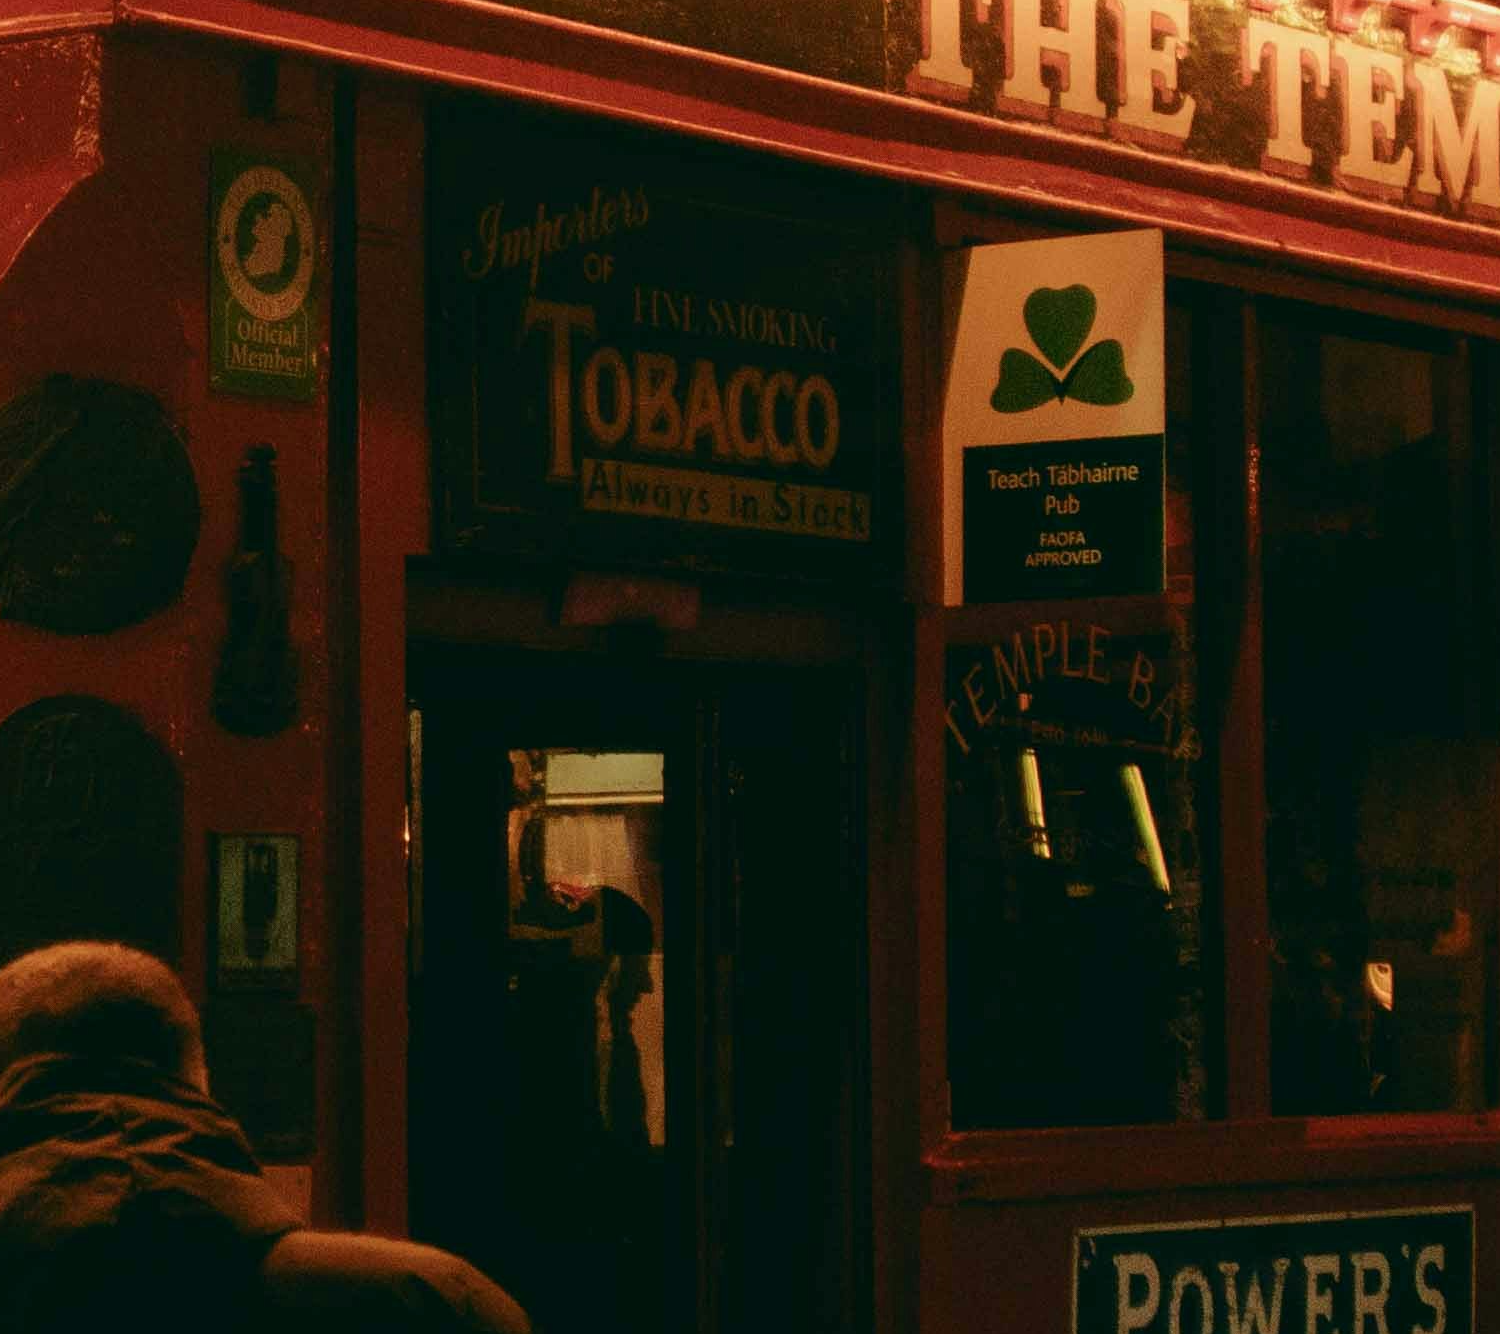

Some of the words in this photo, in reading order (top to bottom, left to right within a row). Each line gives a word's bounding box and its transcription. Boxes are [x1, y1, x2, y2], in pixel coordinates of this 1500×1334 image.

[463, 182, 651, 297] Importers
[583, 253, 615, 283] OF
[237, 318, 300, 347] Official
[634, 286, 701, 335] FINE
[707, 296, 838, 354] SMOKING
[230, 343, 303, 375] Member
[516, 298, 841, 484] TOBACCO
[986, 467, 1041, 490] Teach
[1046, 461, 1140, 487] Tábhairne
[586, 461, 712, 518] Always
[728, 474, 761, 523] in
[772, 482, 869, 535] Stock
[1044, 493, 1081, 517] Pub
[1024, 548, 1104, 568] APPROVED
[943, 618, 1112, 756] TEMPLE
